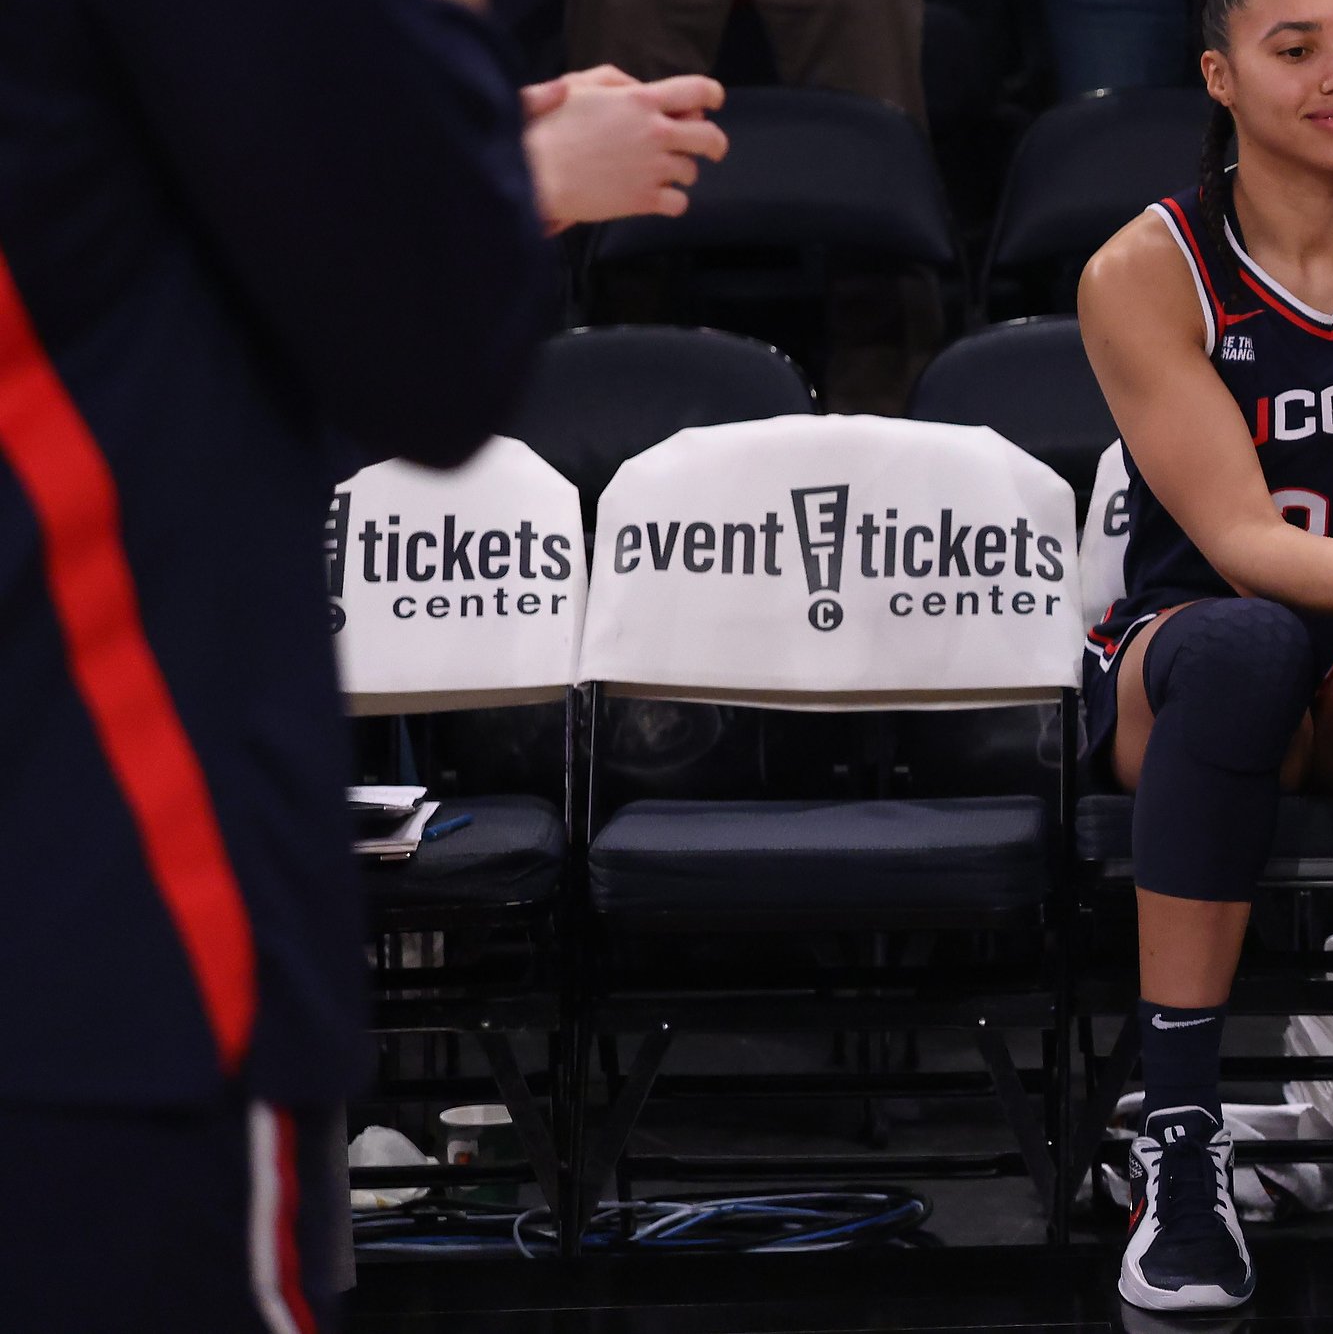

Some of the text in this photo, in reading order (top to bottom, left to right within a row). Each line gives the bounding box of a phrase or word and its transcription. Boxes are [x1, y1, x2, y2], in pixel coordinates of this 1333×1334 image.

[1221, 348, 1256, 362] HANG
[359, 515, 571, 582] tickets
[614, 513, 784, 576] event
[857, 509, 1064, 582] tickets
[393, 588, 567, 619] center
[890, 585, 1061, 617] center
